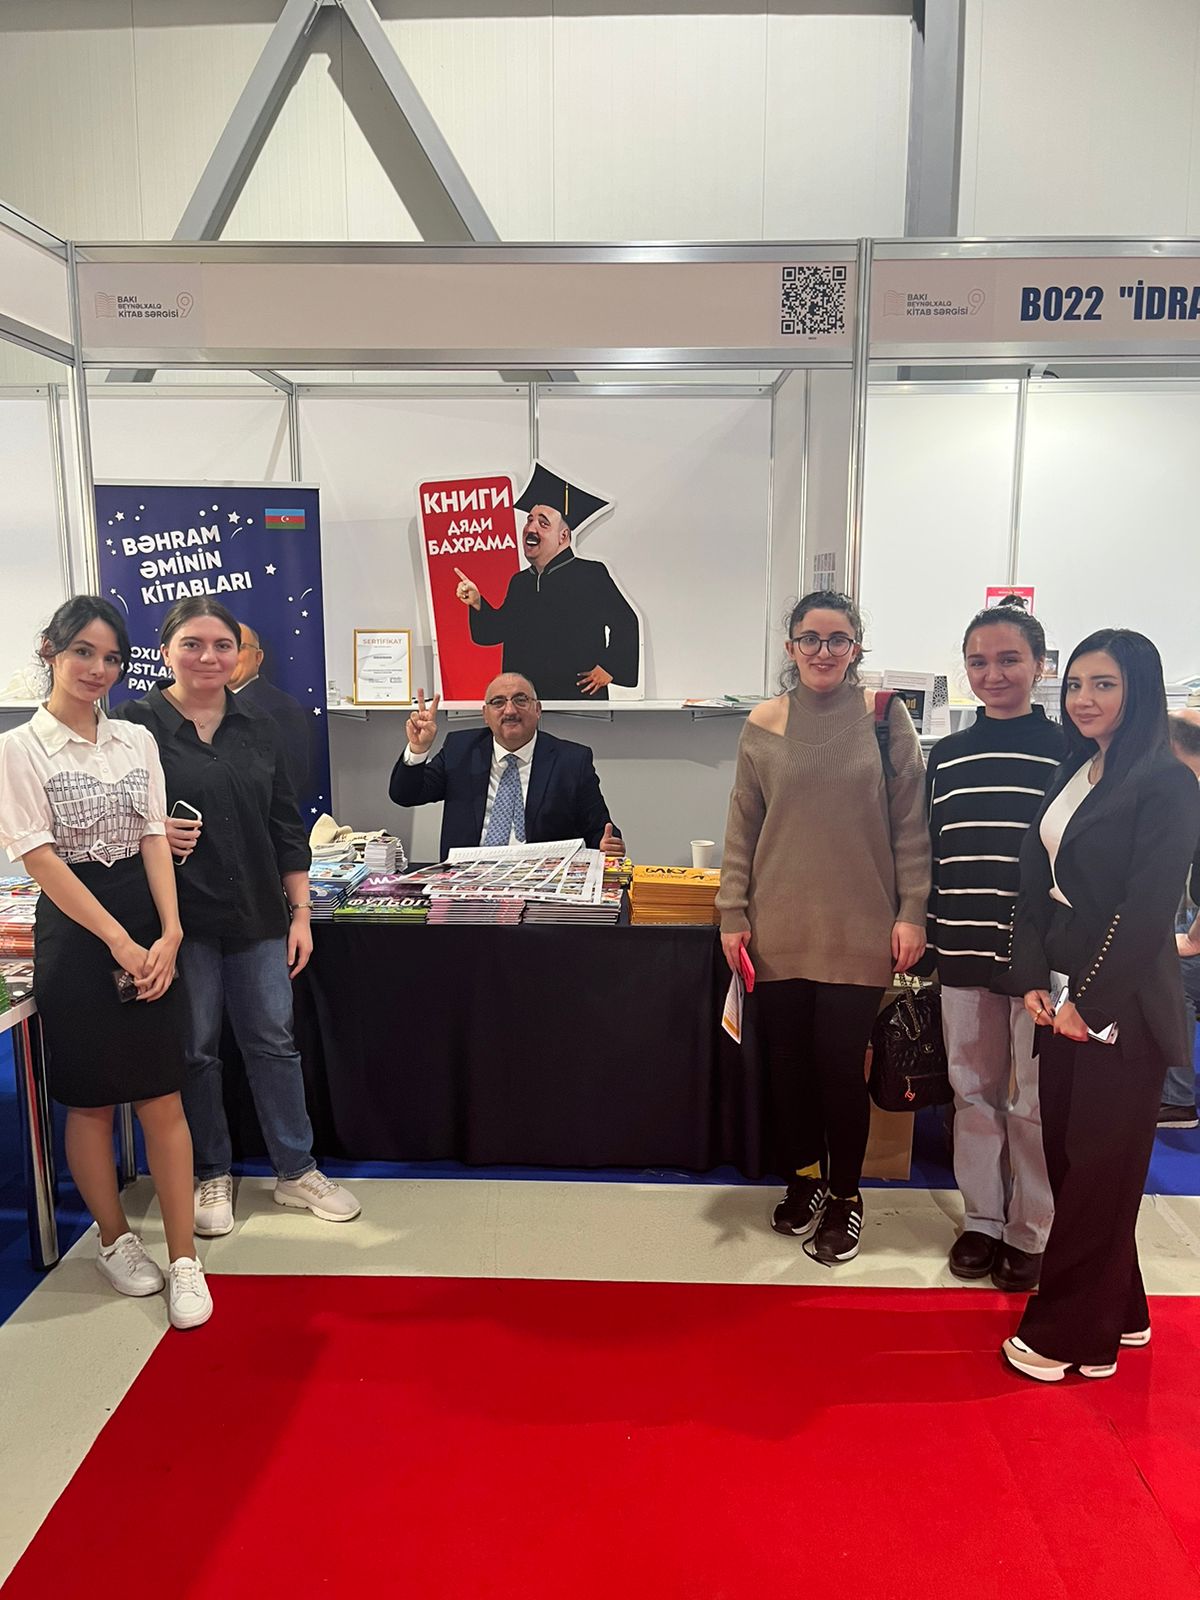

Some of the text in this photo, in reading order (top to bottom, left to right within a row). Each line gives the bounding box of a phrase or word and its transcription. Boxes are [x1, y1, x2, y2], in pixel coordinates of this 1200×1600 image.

[907, 293, 928, 301] BAKI
[118, 309, 179, 318] KİTAB SƏRGİSİ
[906, 306, 969, 316] KİTAB SƏRGİSİ
[423, 486, 511, 514] КНИГИ
[447, 517, 493, 536] ДЯДИ
[121, 525, 221, 557] BƏHRAM
[428, 533, 516, 556] БАХРАМА
[139, 548, 223, 580] ƏMİNİN
[141, 571, 253, 605] KİTABLARI
